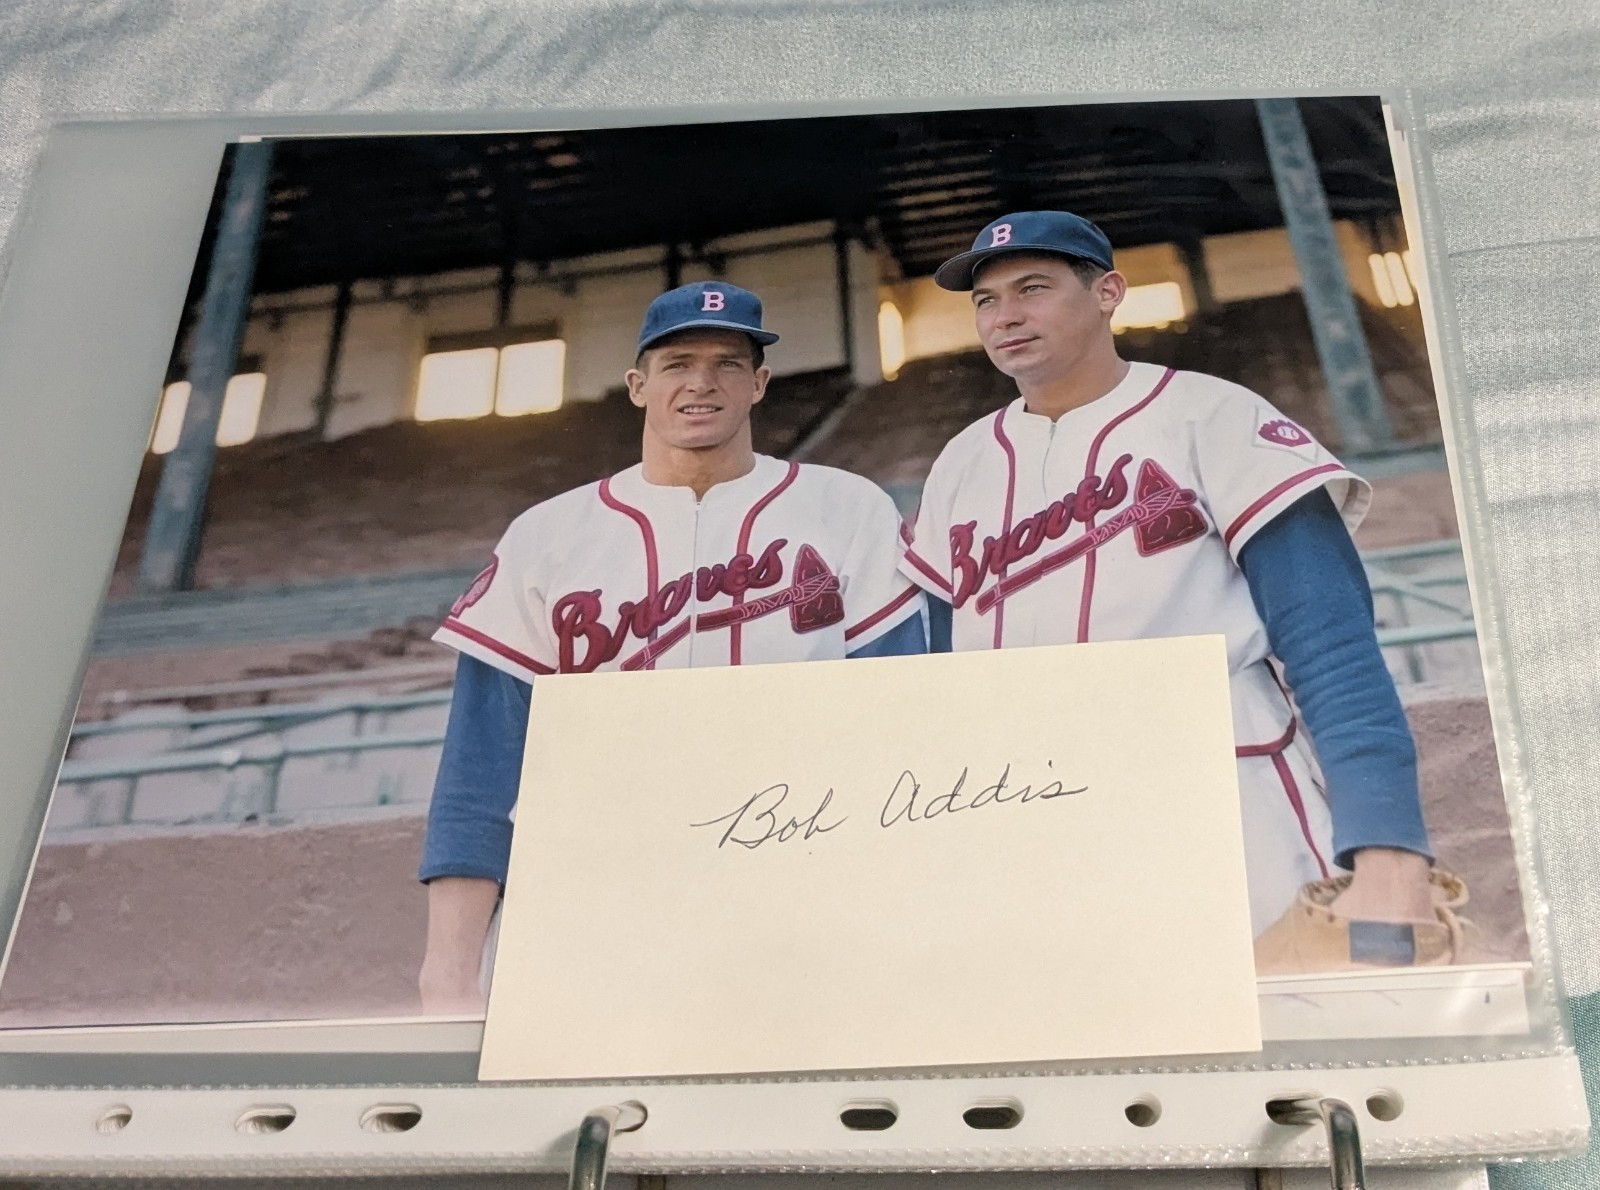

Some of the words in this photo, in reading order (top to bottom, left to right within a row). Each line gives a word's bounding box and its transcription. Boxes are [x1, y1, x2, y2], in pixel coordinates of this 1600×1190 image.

[990, 223, 1012, 247] B
[701, 291, 725, 312] B
[552, 538, 788, 674] Braves
[690, 783, 848, 849] Bob
